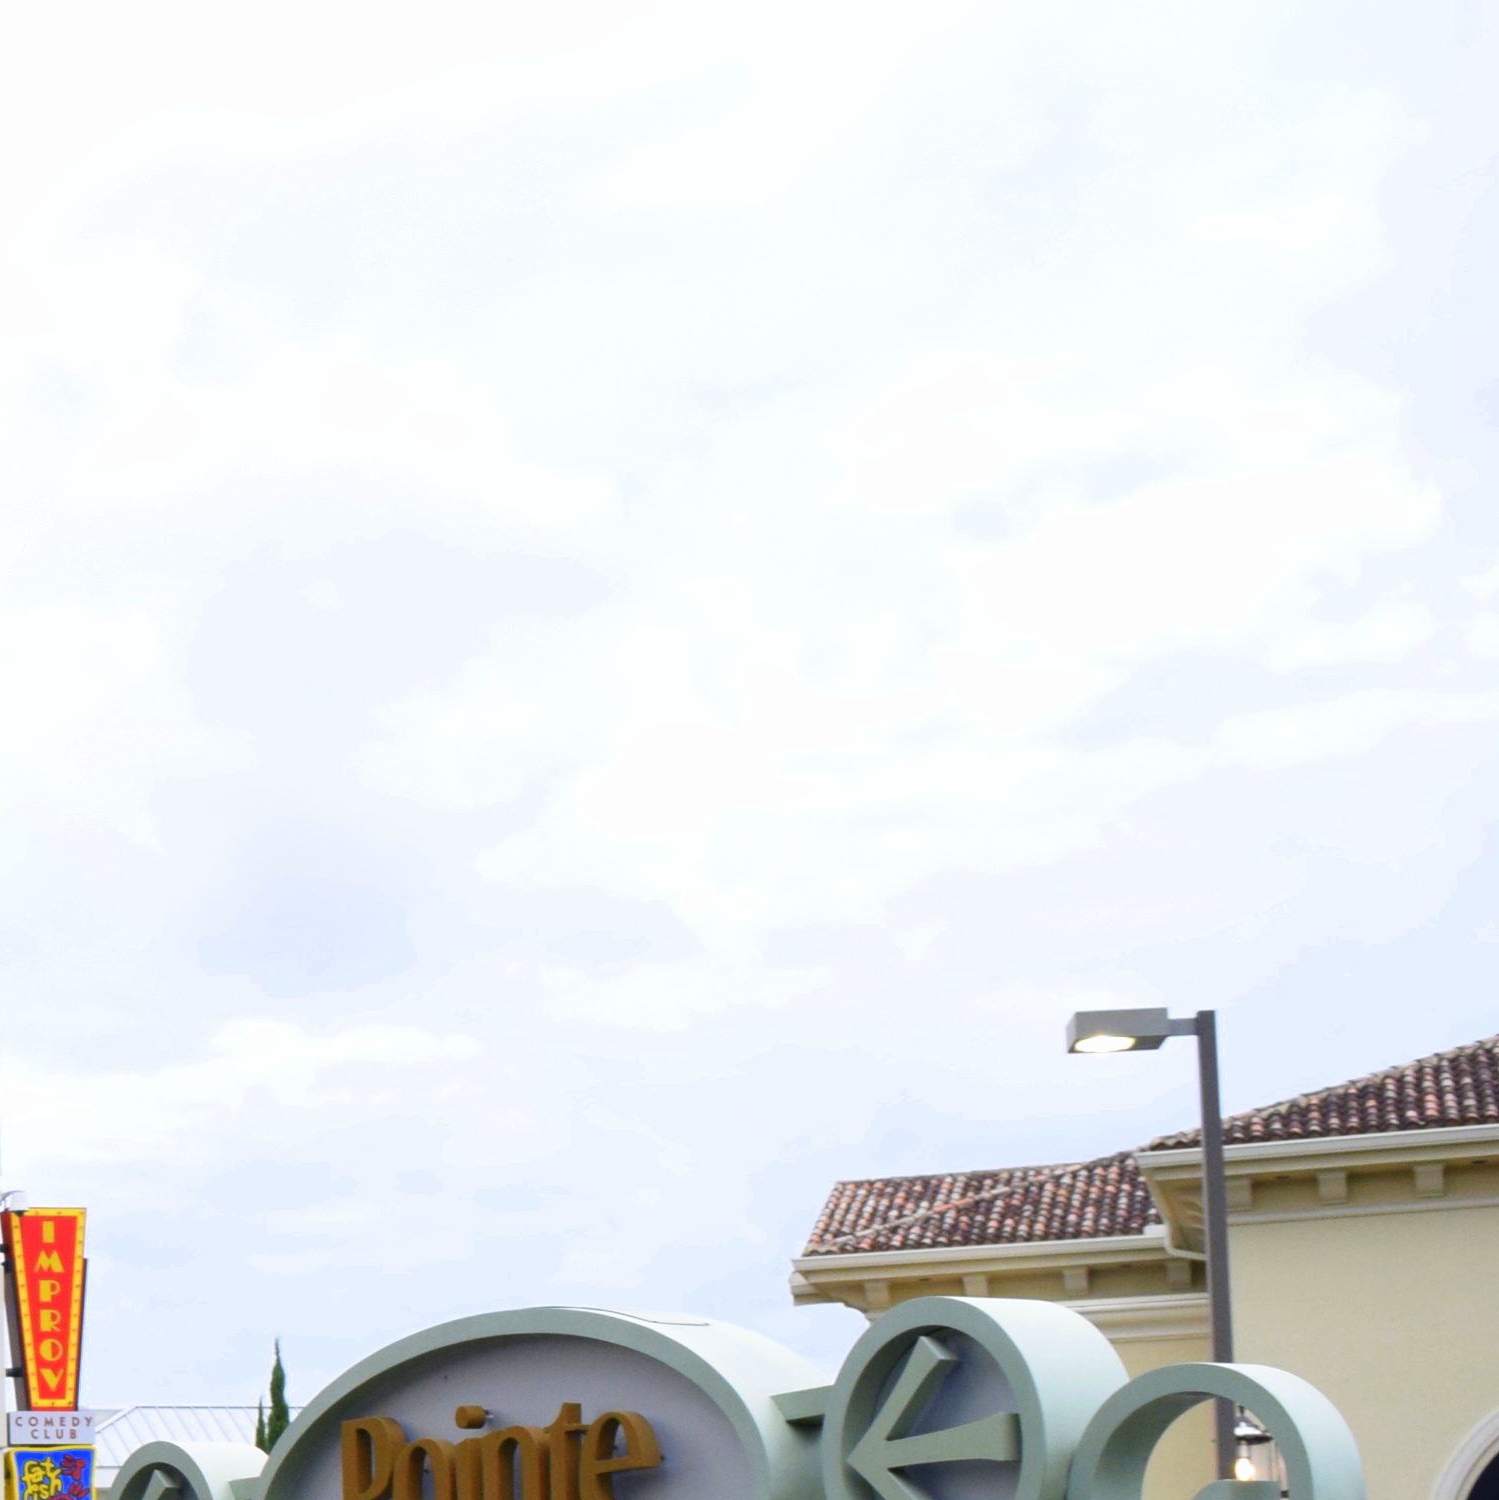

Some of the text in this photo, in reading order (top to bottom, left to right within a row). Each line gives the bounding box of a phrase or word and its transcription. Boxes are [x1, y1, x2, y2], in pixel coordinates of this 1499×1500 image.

[34, 1220, 65, 1392] IMPROV
[15, 1416, 93, 1427] COMEDY
[30, 1428, 77, 1440] CLUB
